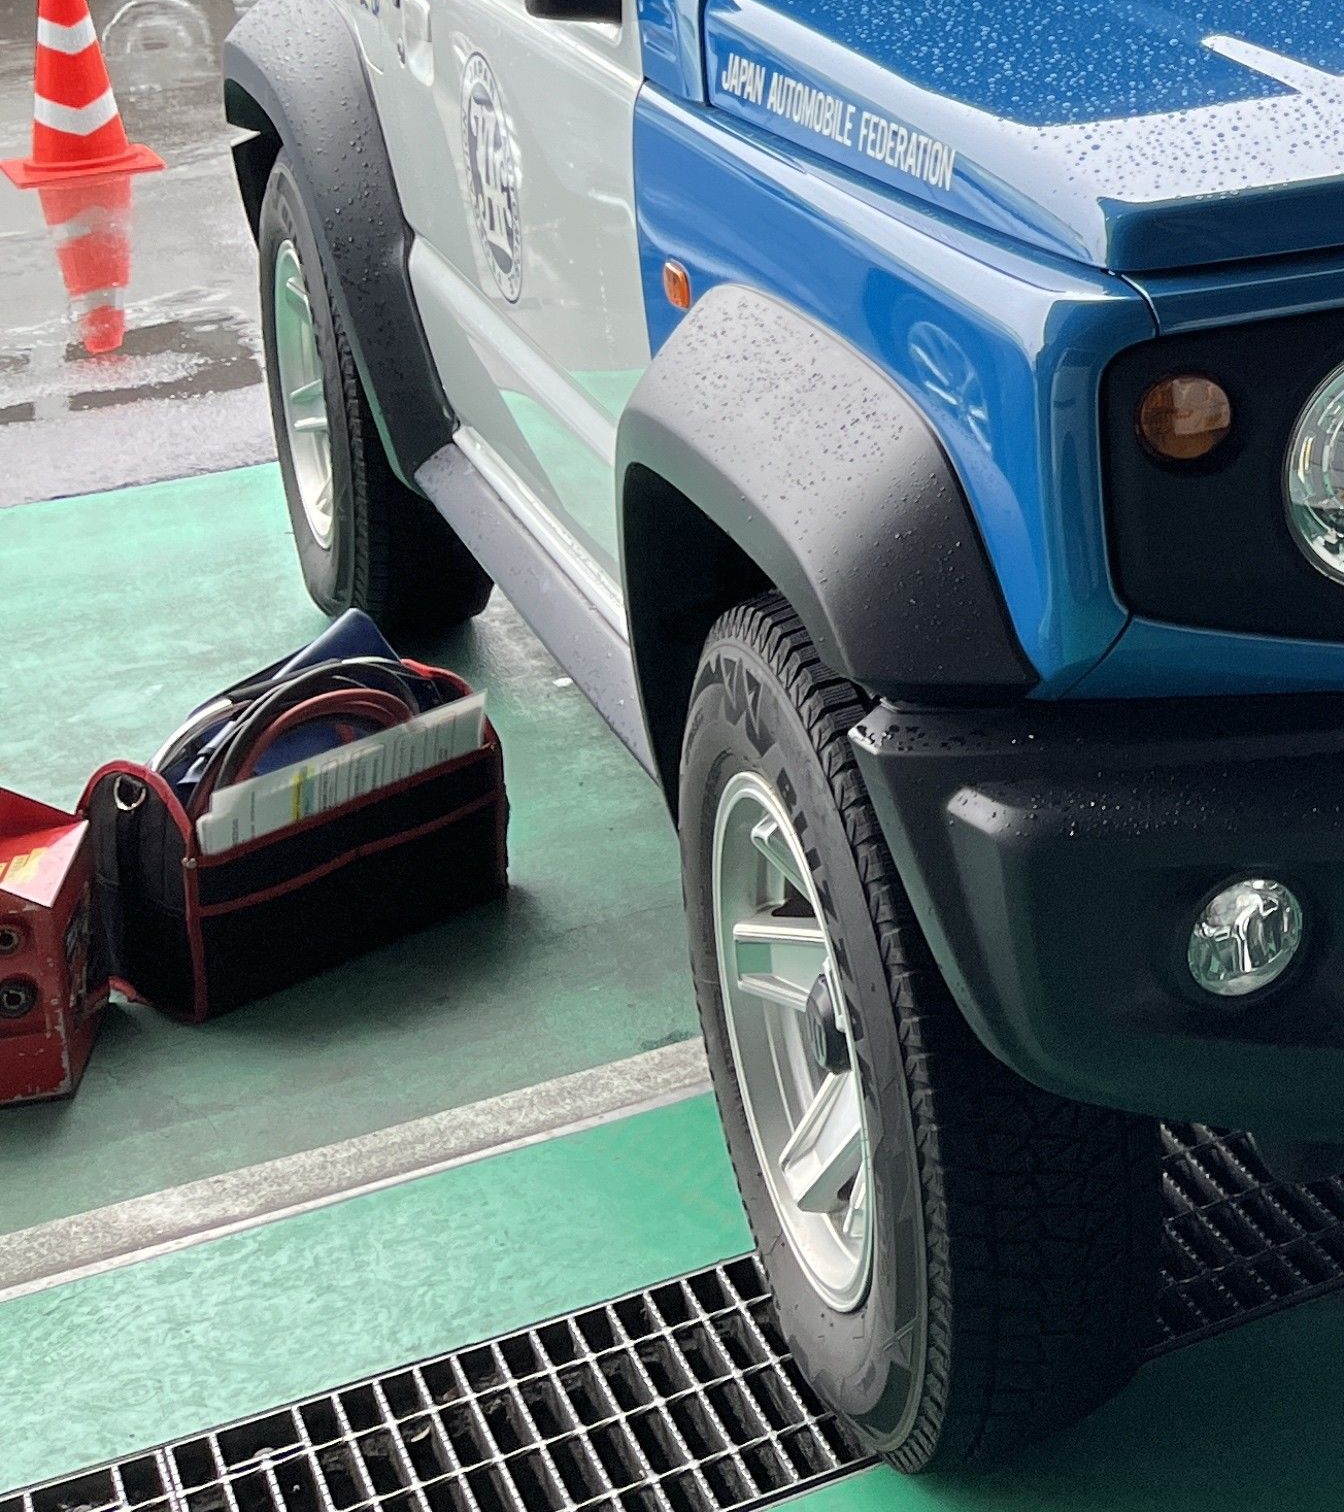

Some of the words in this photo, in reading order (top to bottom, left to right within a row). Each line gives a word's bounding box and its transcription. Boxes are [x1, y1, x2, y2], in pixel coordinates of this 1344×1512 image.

[721, 53, 766, 105] JAPAN
[767, 72, 856, 147] AUTOMOBILE
[858, 111, 956, 191] FEDERATION
